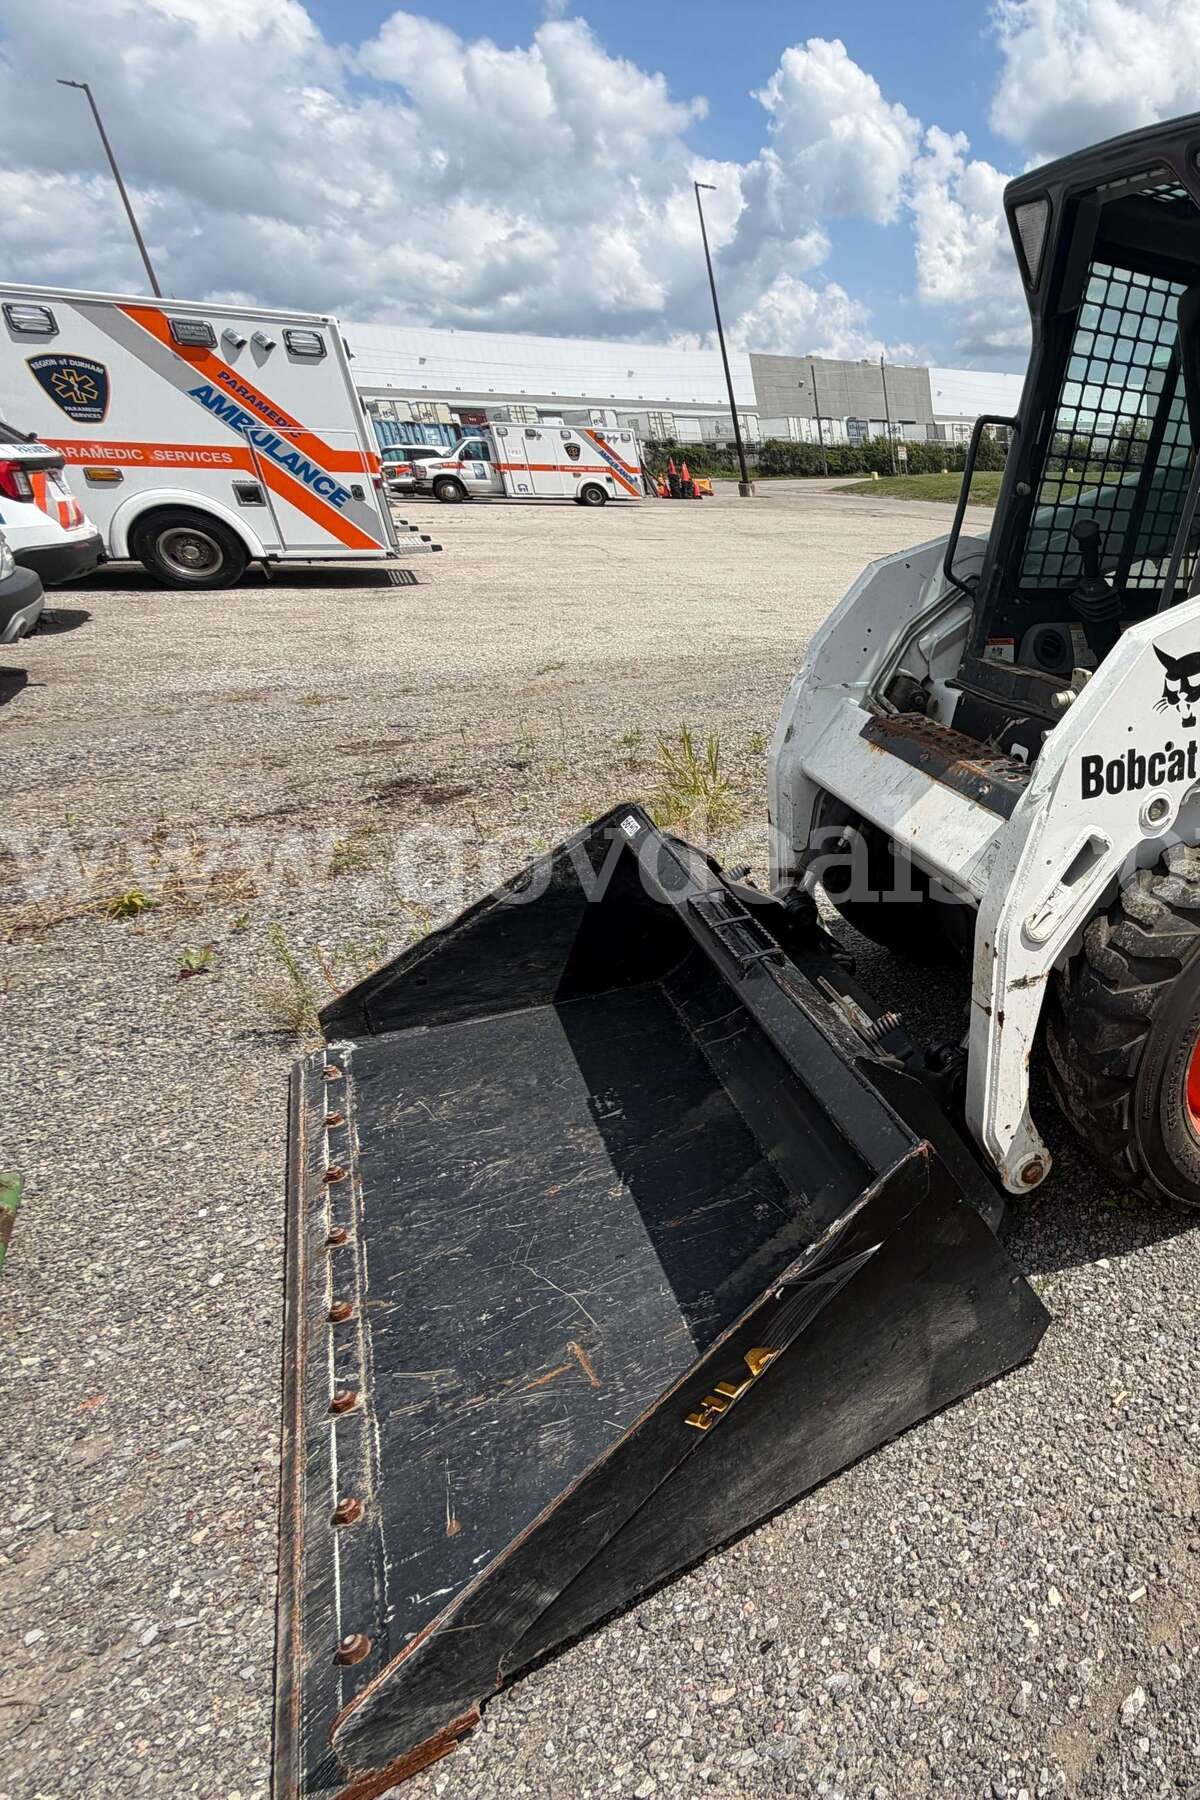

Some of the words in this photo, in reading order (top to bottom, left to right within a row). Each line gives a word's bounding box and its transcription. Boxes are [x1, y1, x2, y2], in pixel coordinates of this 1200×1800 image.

[56, 446, 144, 461] ARAMEDIC
[153, 449, 233, 463] SERVICES
[187, 384, 353, 508] AMBULANCE
[1081, 739, 1198, 801] Bobcat
